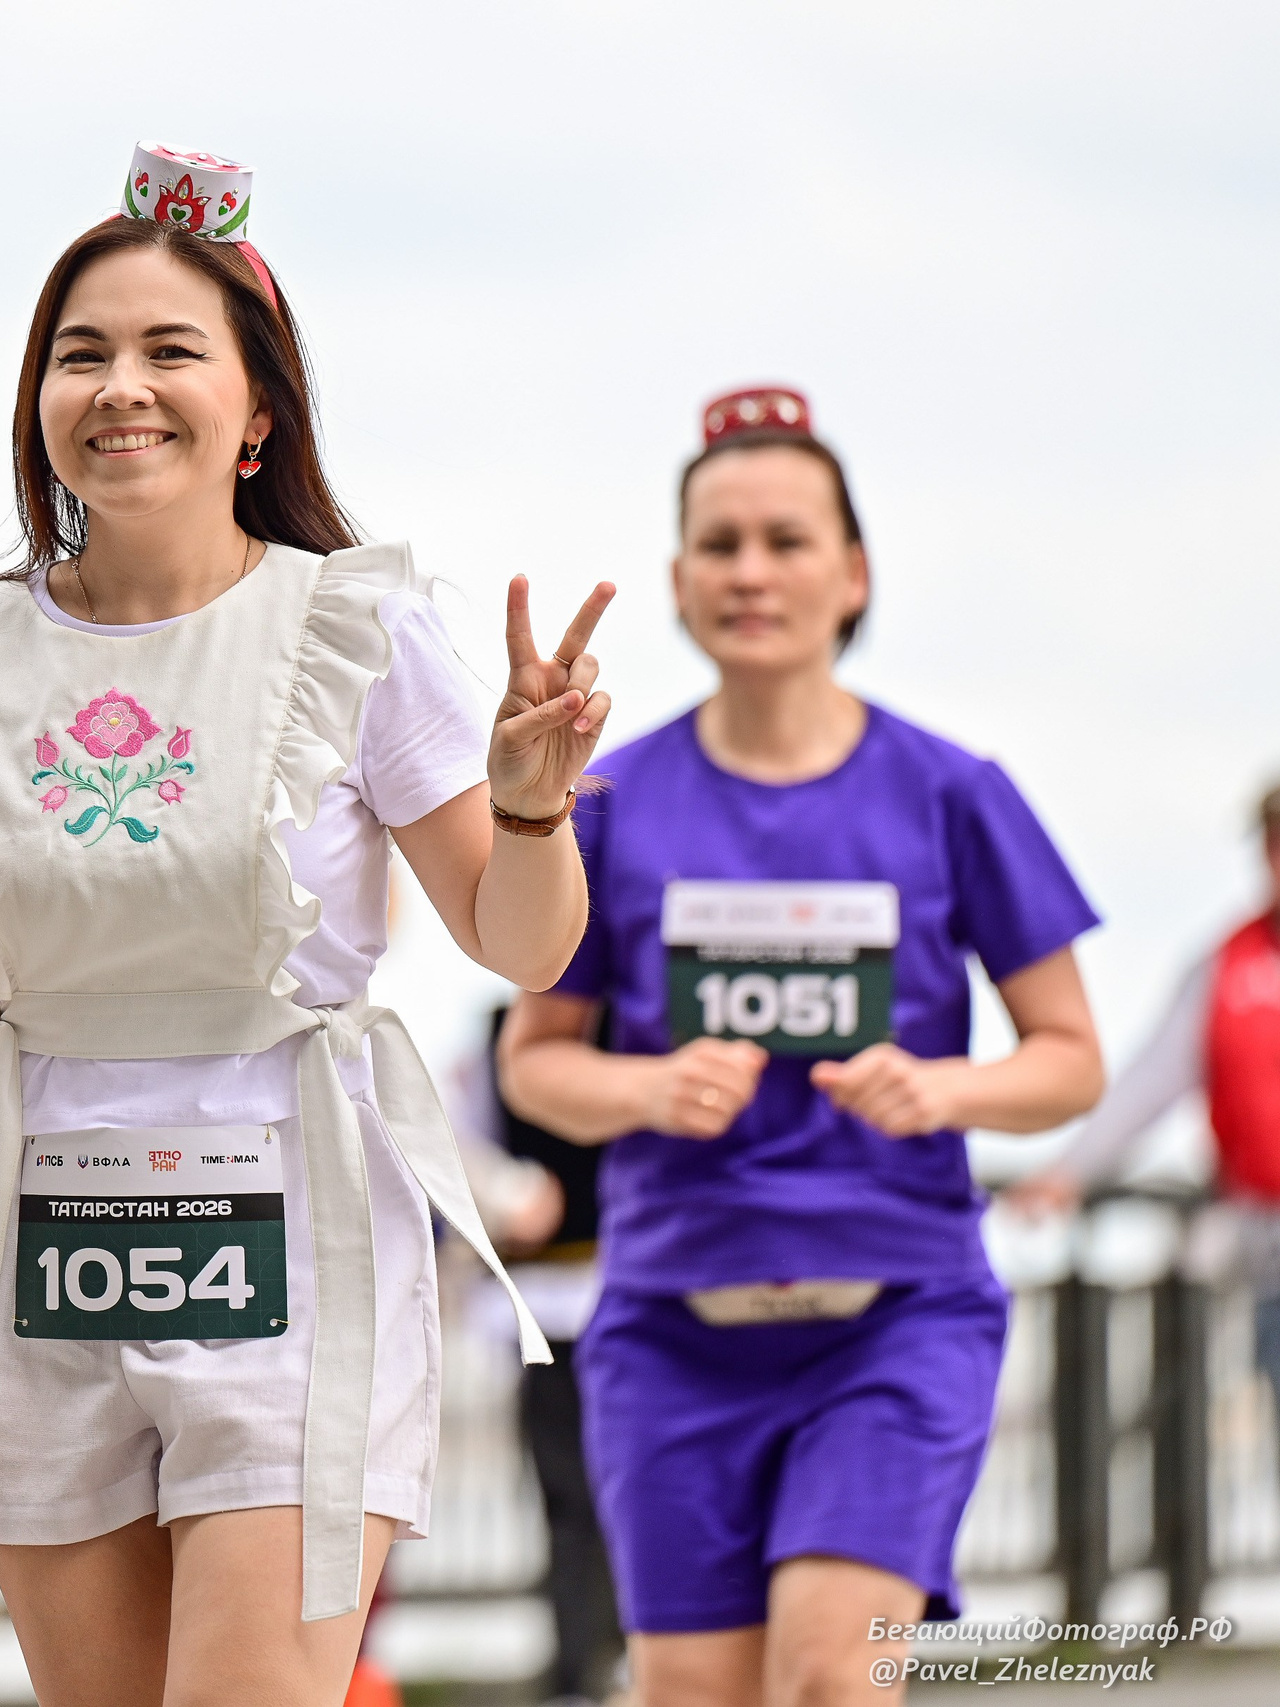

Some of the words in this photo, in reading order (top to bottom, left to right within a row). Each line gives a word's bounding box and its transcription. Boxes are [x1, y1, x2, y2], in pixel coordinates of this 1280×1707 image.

[695, 973, 859, 1038] 1051
[44, 1155, 64, 1167] ПСБ
[92, 1156, 131, 1167] ВФЛА
[148, 1150, 182, 1162] ЭТНО
[152, 1161, 177, 1172] РАН
[48, 1200, 169, 1218] ТАТАРСТАН
[176, 1199, 233, 1217] 2026
[37, 1245, 256, 1312] 1054
